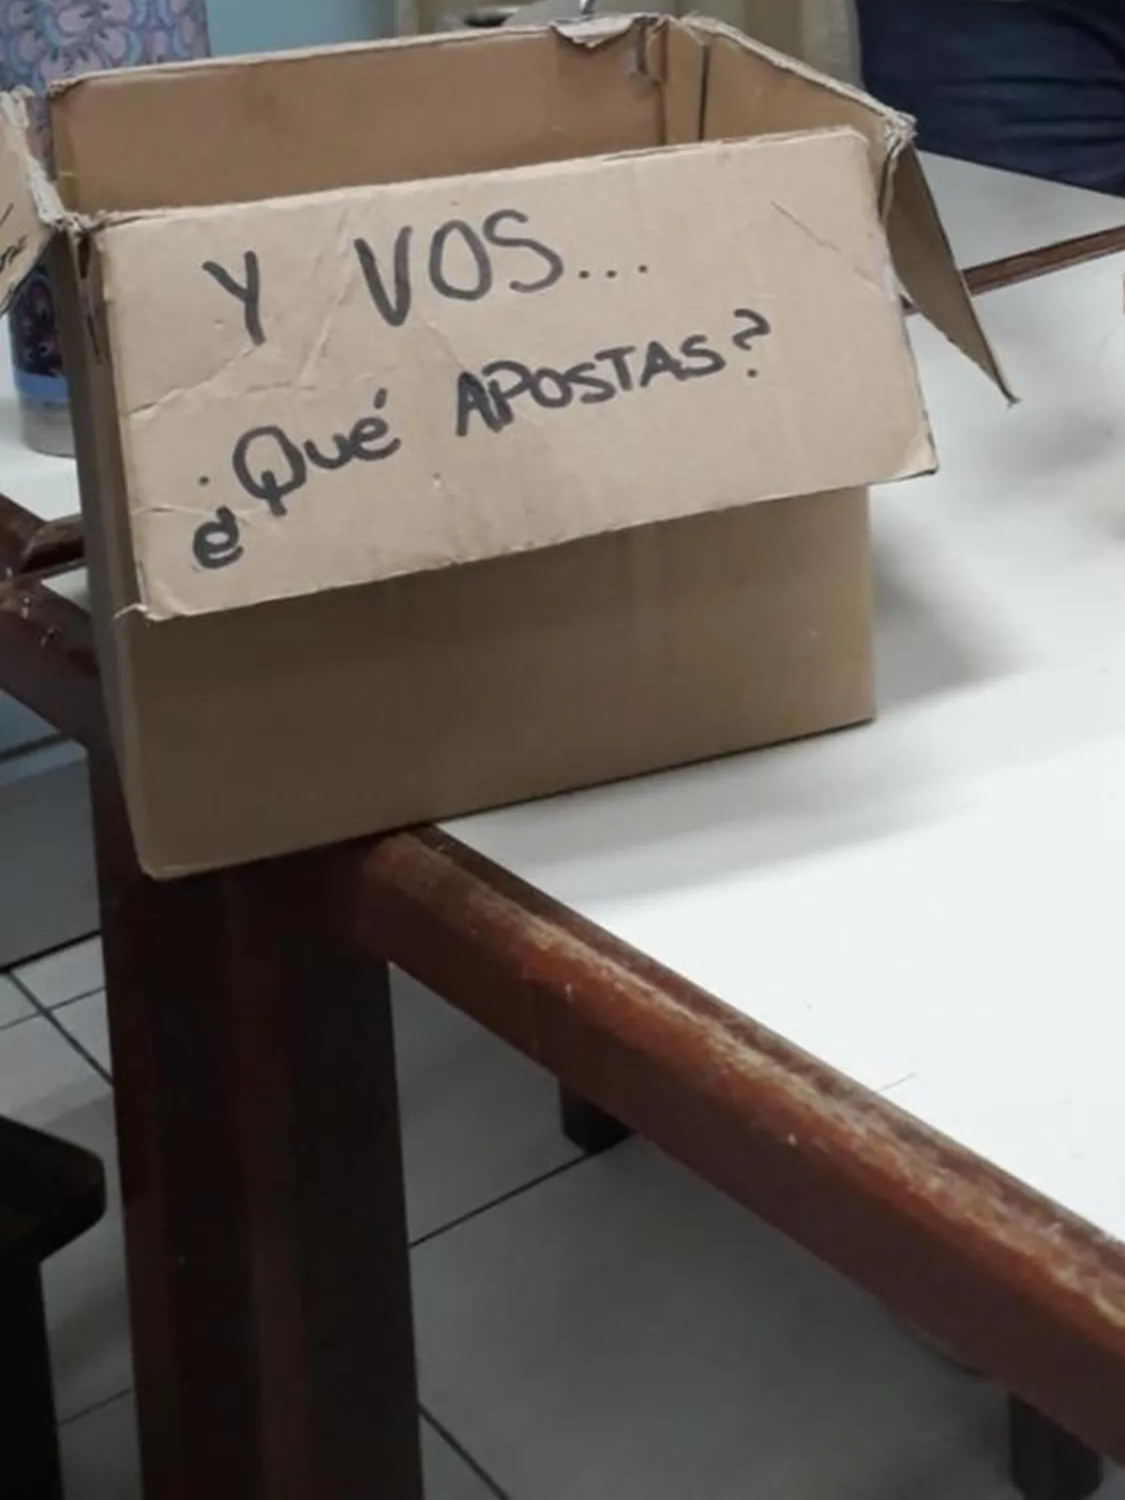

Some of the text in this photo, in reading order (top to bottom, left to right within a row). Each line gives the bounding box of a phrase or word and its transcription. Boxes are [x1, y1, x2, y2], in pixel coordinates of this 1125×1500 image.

[202, 208, 650, 345] Y VOS...
[454, 308, 772, 438] APOSTAS?
